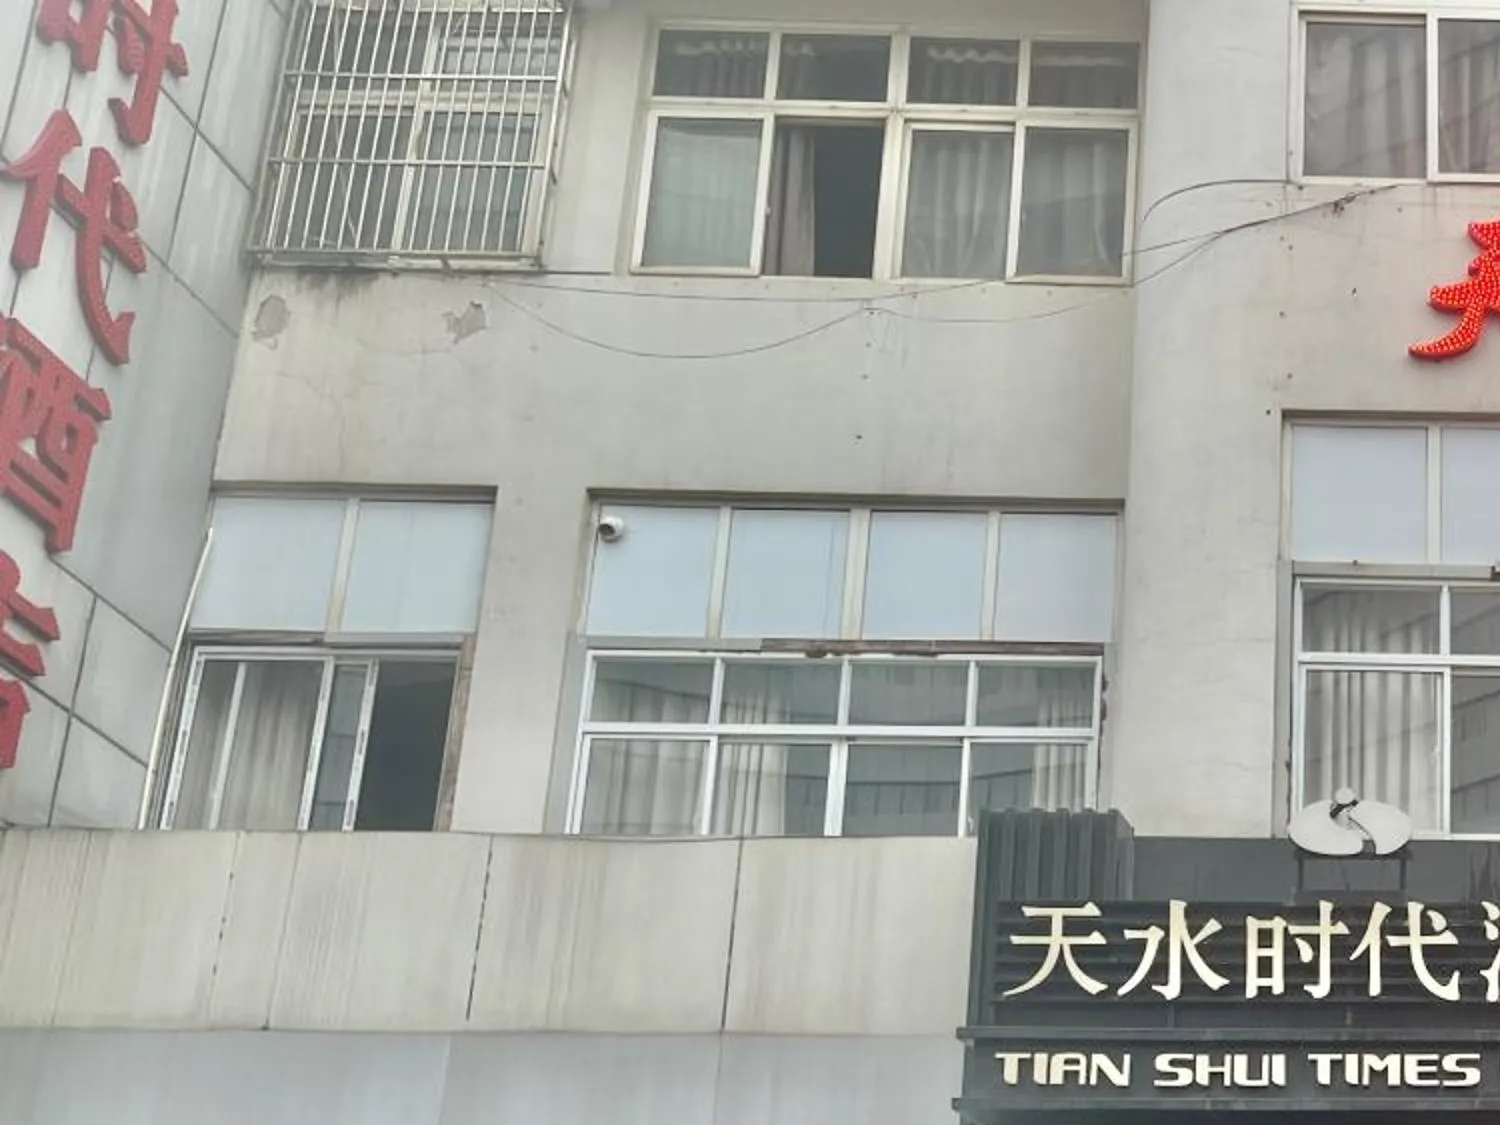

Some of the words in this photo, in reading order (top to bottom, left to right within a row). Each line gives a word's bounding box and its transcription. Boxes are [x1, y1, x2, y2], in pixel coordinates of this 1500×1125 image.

[995, 1051, 1131, 1086] TIAN
[1152, 1053, 1287, 1088] SHUI
[1307, 1053, 1480, 1087] TIMES
